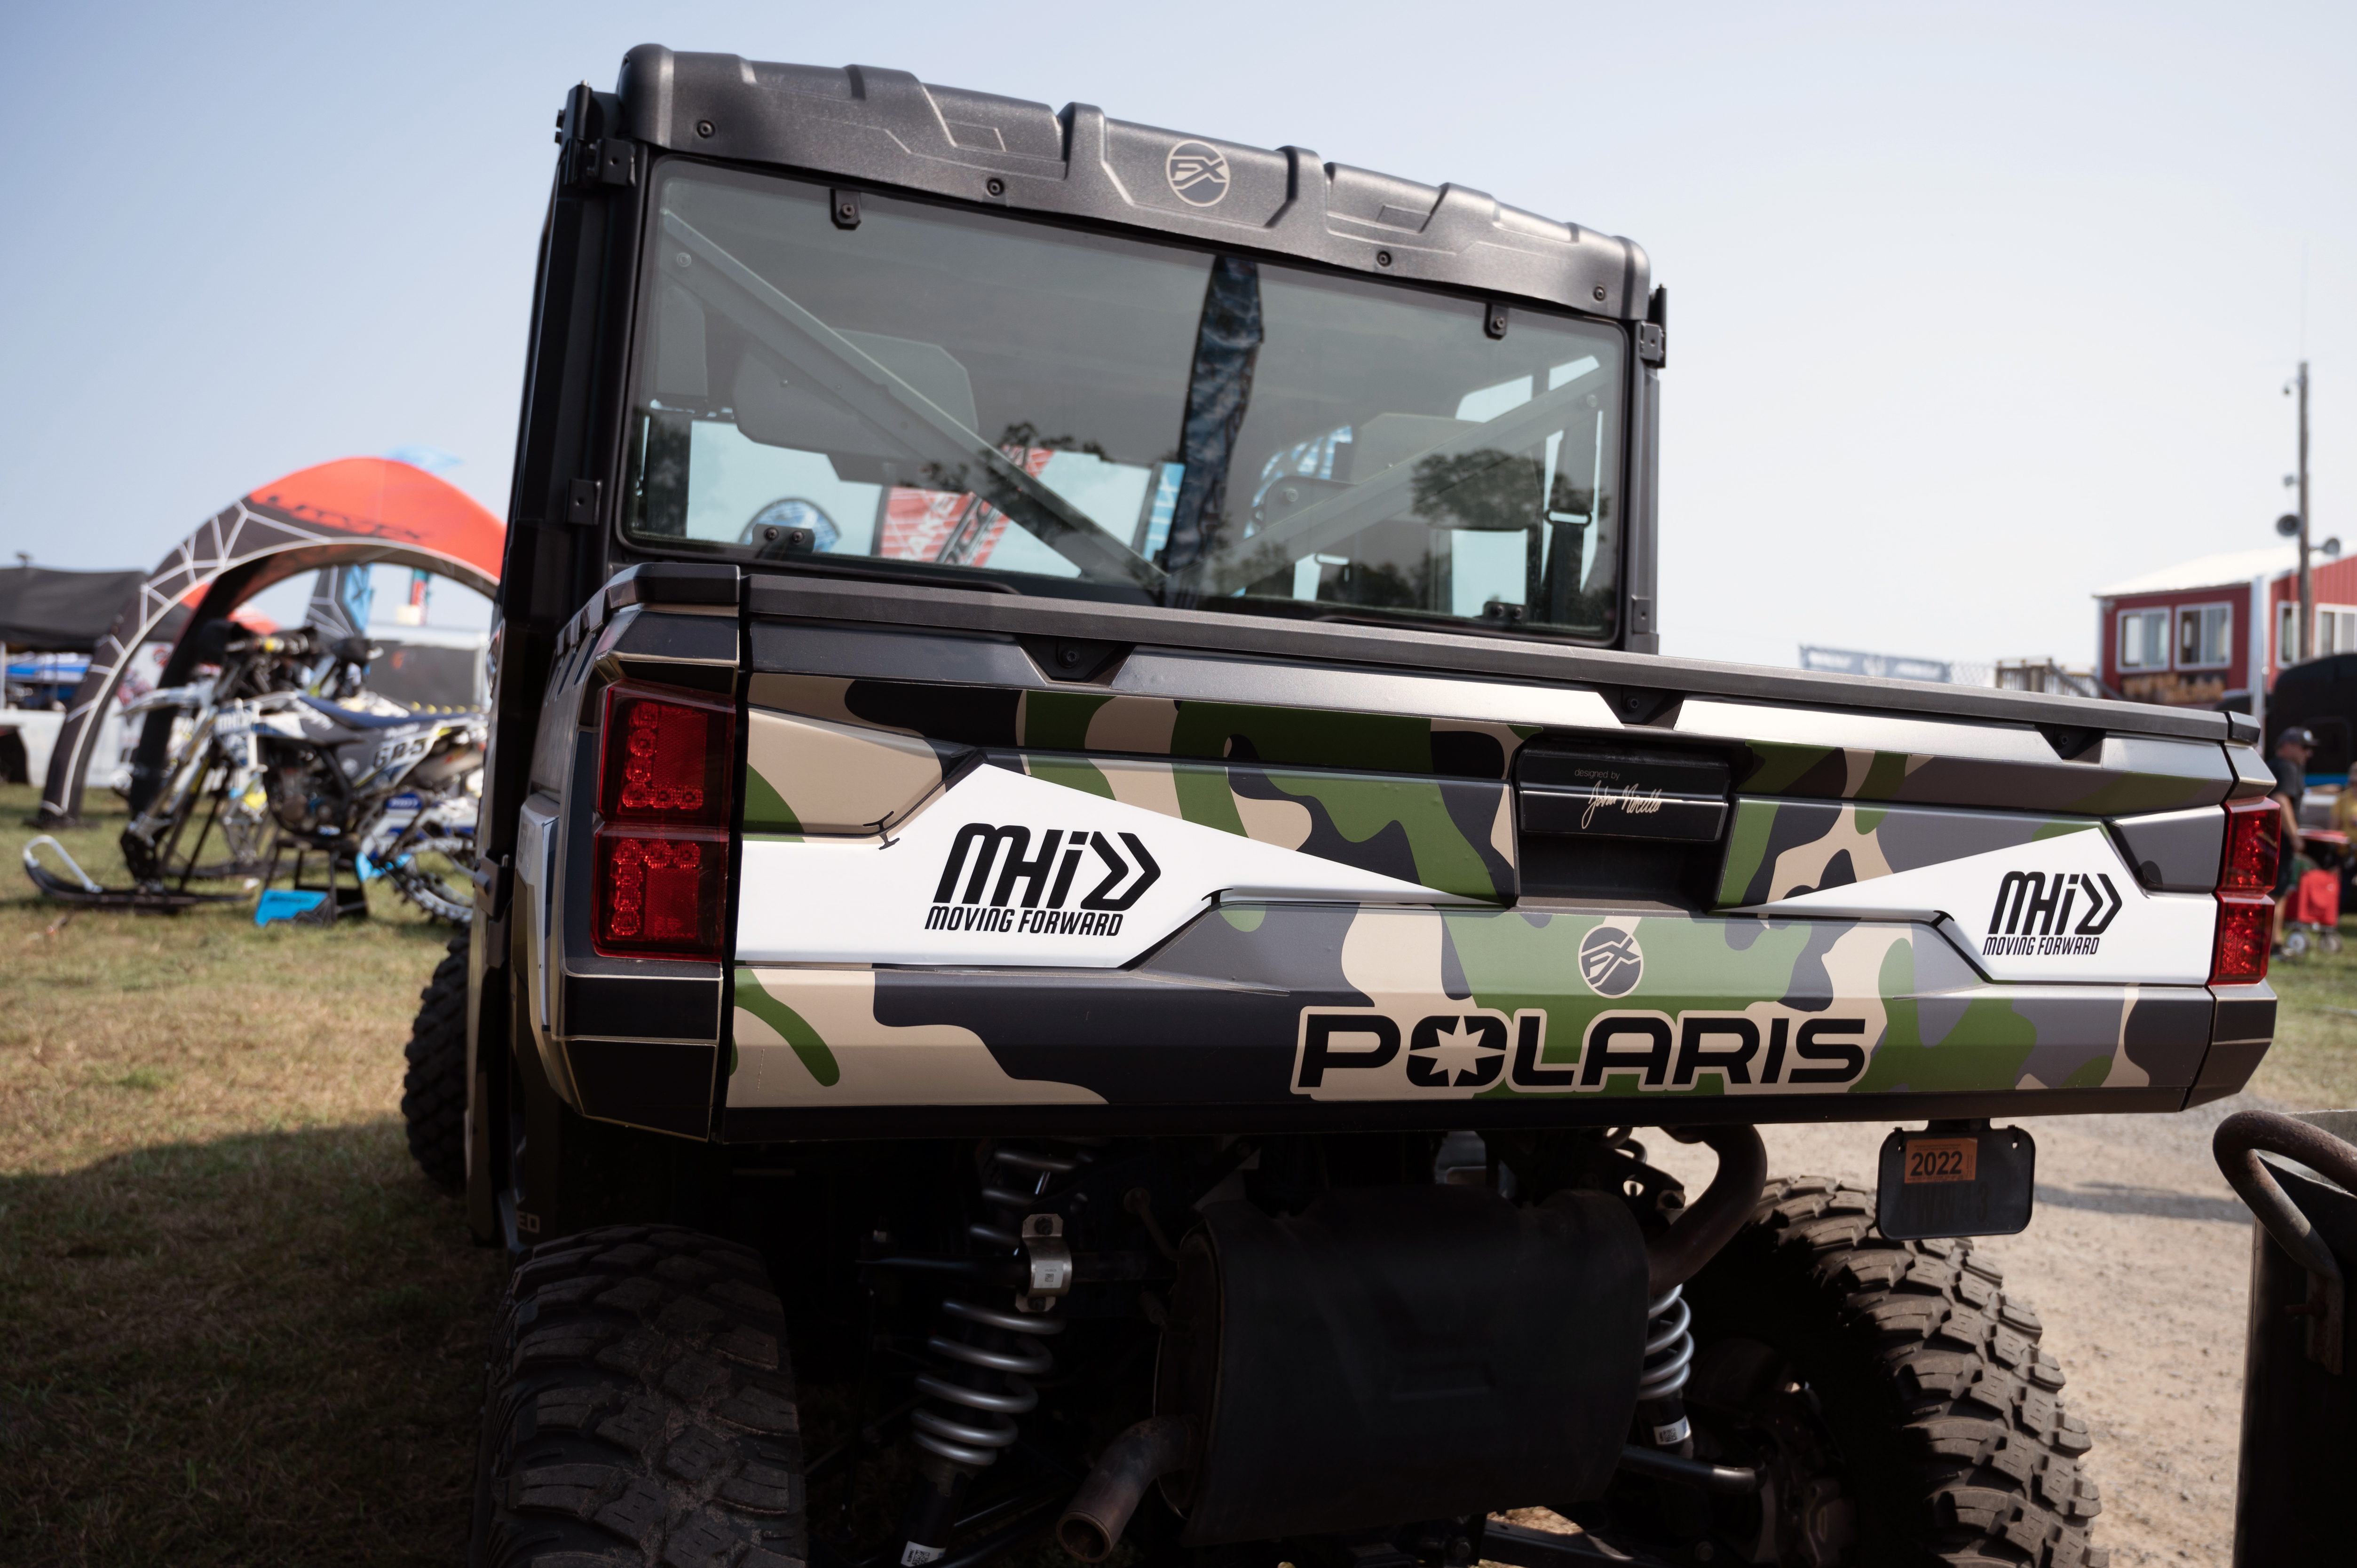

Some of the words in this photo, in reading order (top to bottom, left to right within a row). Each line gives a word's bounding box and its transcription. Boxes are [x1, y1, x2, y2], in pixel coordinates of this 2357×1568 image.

[1574, 768, 1608, 779] designed
[1611, 771, 1621, 781] by
[1582, 780, 1617, 829] John
[925, 906, 1014, 932] MOVING
[1018, 910, 1123, 937] FORWARD
[1982, 937, 2034, 955] MOVING
[2037, 937, 2100, 955] FORWARD
[1298, 1014, 1866, 1088] POLARIS
[1910, 1150, 1962, 1176] 2022
